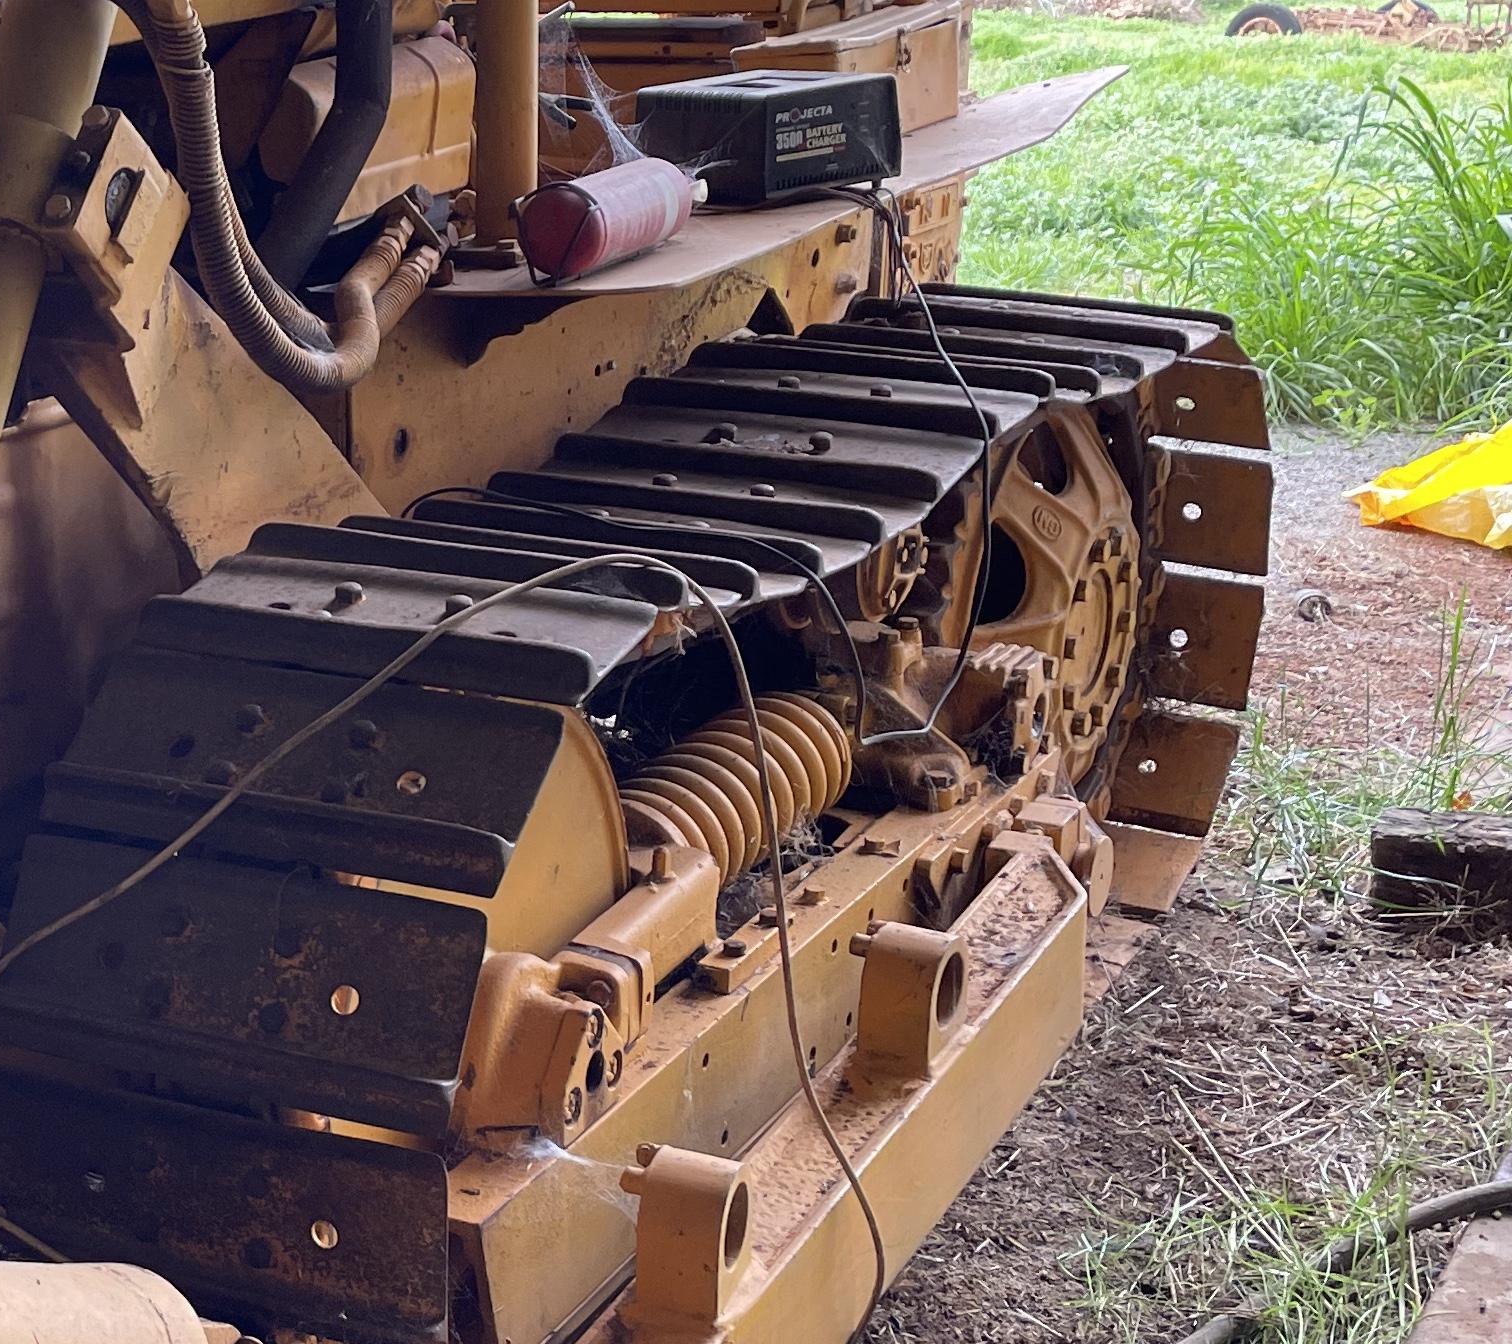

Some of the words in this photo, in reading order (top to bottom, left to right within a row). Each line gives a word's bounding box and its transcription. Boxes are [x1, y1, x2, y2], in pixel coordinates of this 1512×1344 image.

[775, 105, 833, 123] PROJECTA
[806, 122, 843, 138] BATTERY
[775, 130, 803, 150] 3500
[806, 133, 846, 148] CHARGER
